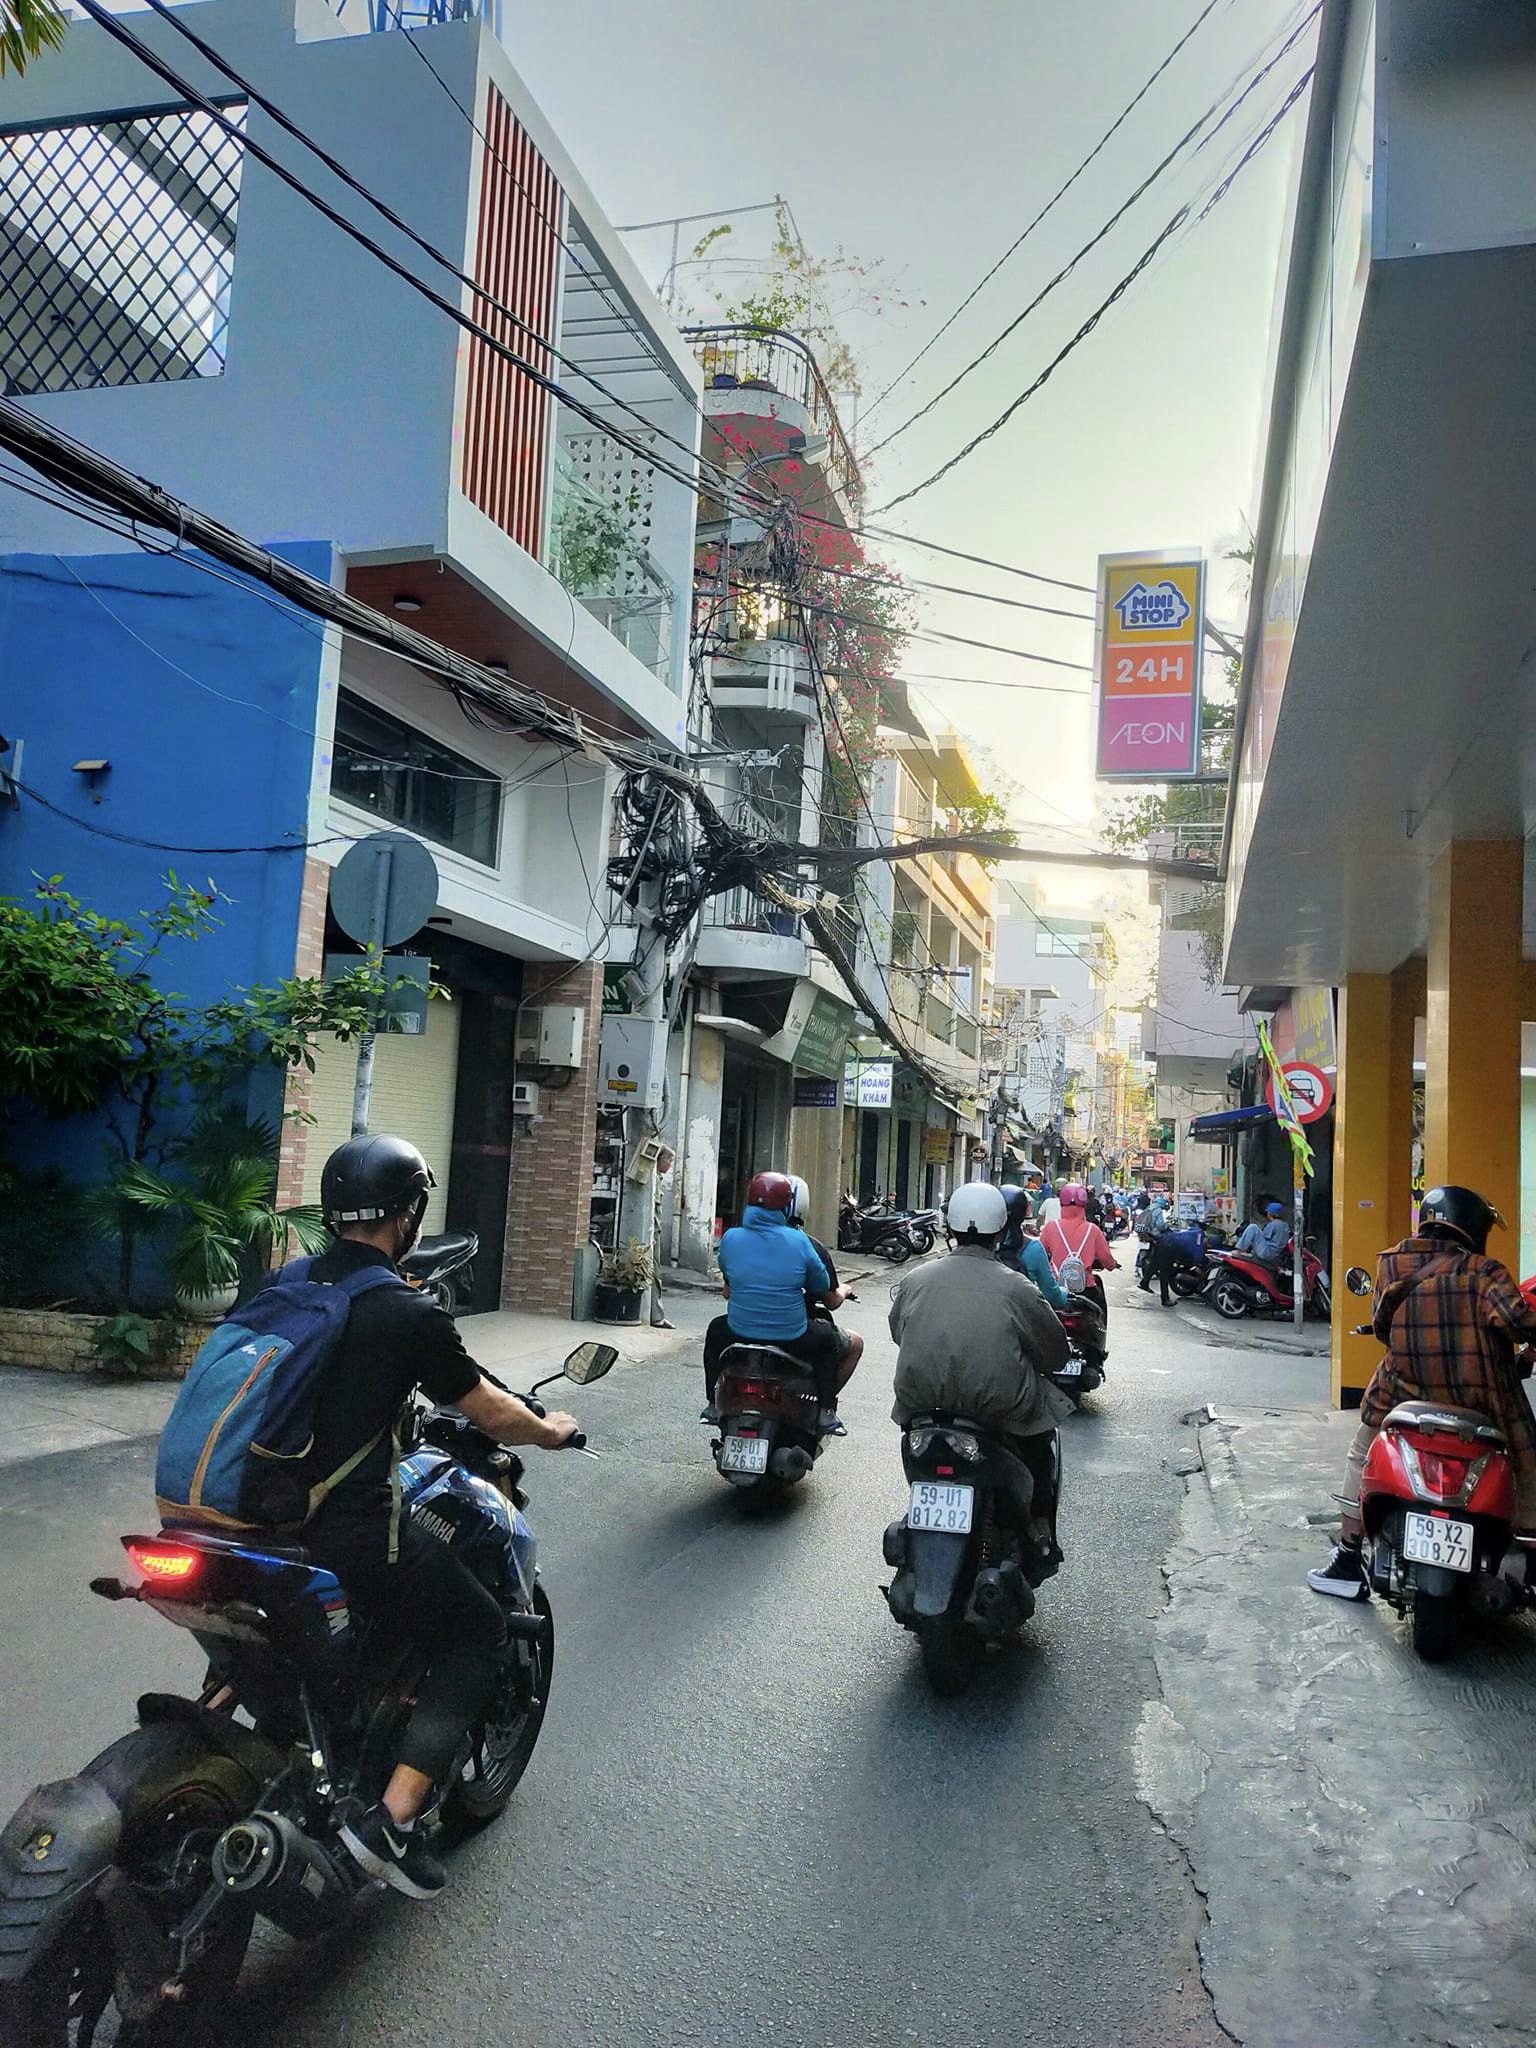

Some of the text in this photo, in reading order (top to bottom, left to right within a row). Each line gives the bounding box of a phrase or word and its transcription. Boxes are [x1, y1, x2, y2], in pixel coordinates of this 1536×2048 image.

[1132, 593, 1174, 610] MINI
[1130, 608, 1175, 624] STOP
[1116, 656, 1184, 684] 24H
[920, 1486, 962, 1507] 59-U1
[411, 1504, 456, 1544] YAMAHA
[913, 1507, 967, 1529] 812.82
[1416, 1518, 1463, 1545] 59-X2
[1408, 1538, 1468, 1566] 308.77
